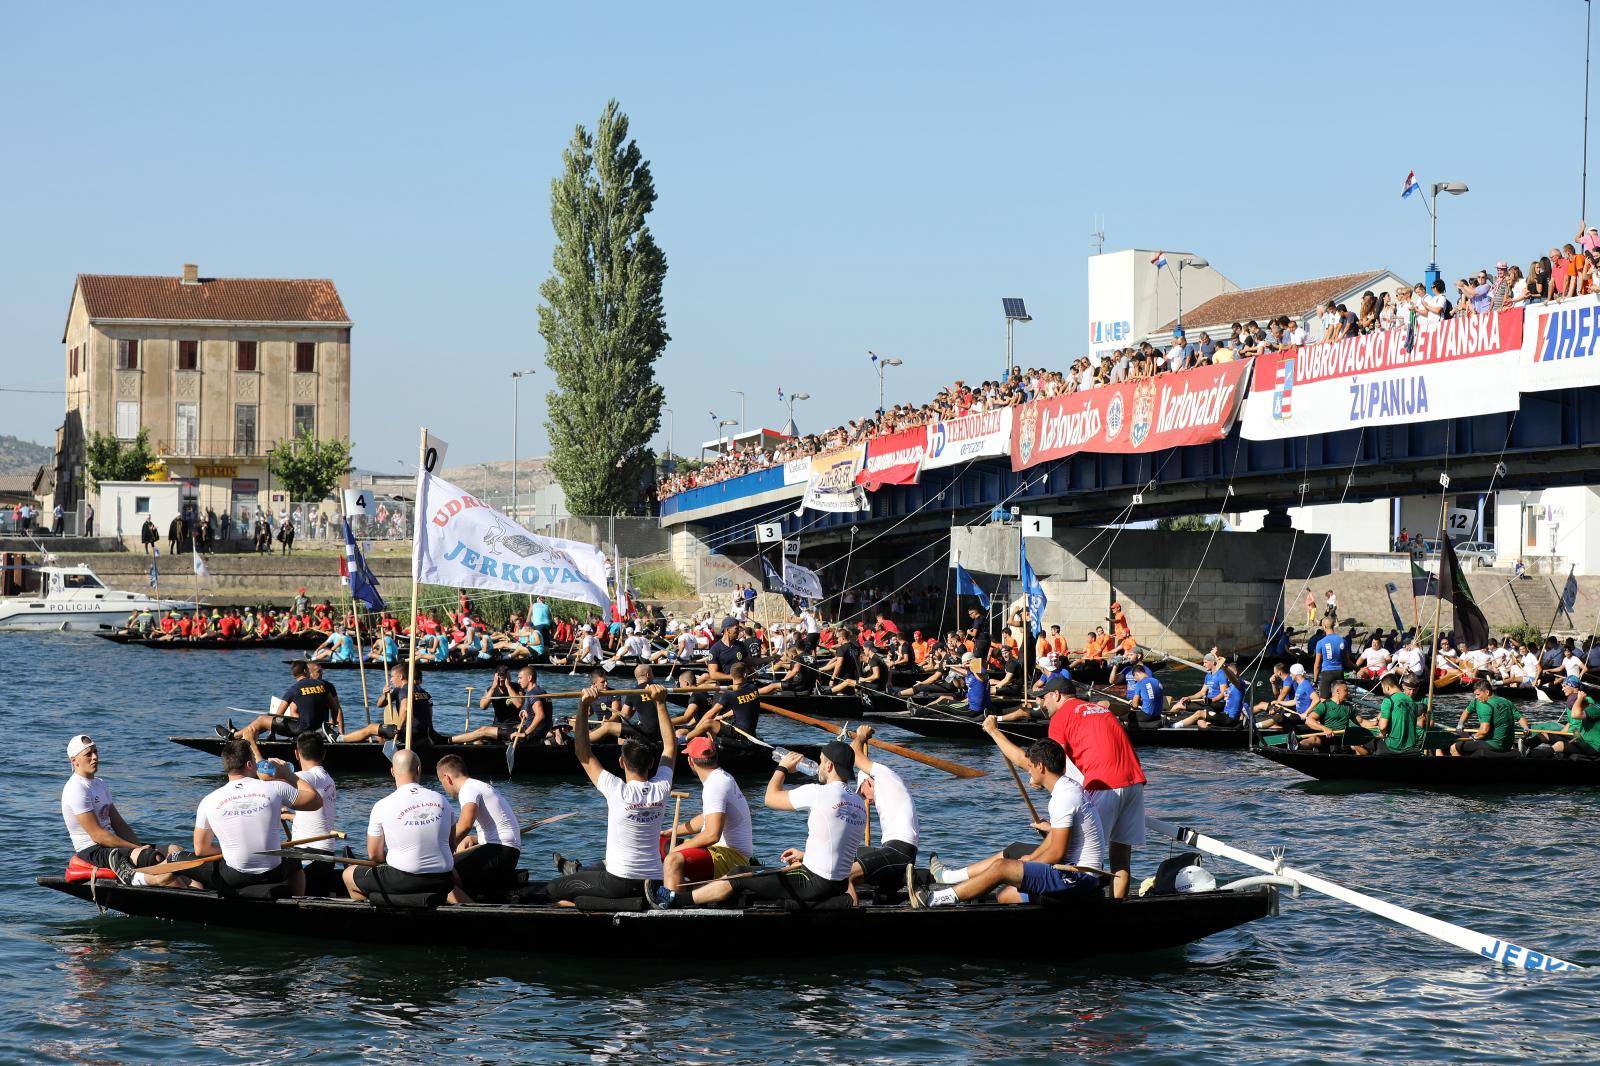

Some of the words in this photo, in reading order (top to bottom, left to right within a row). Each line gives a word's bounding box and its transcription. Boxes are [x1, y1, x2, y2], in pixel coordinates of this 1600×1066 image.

[1105, 320, 1131, 342] HEP
[1350, 375, 1428, 421] ŽUPANIJA
[1039, 398, 1101, 452] Karlovačko
[356, 494, 367, 509] 4
[1033, 520, 1040, 532] 1
[1449, 513, 1468, 529] 12
[766, 527, 774, 538] 3
[787, 543, 798, 552] 20
[50, 603, 101, 612] POLICIJA
